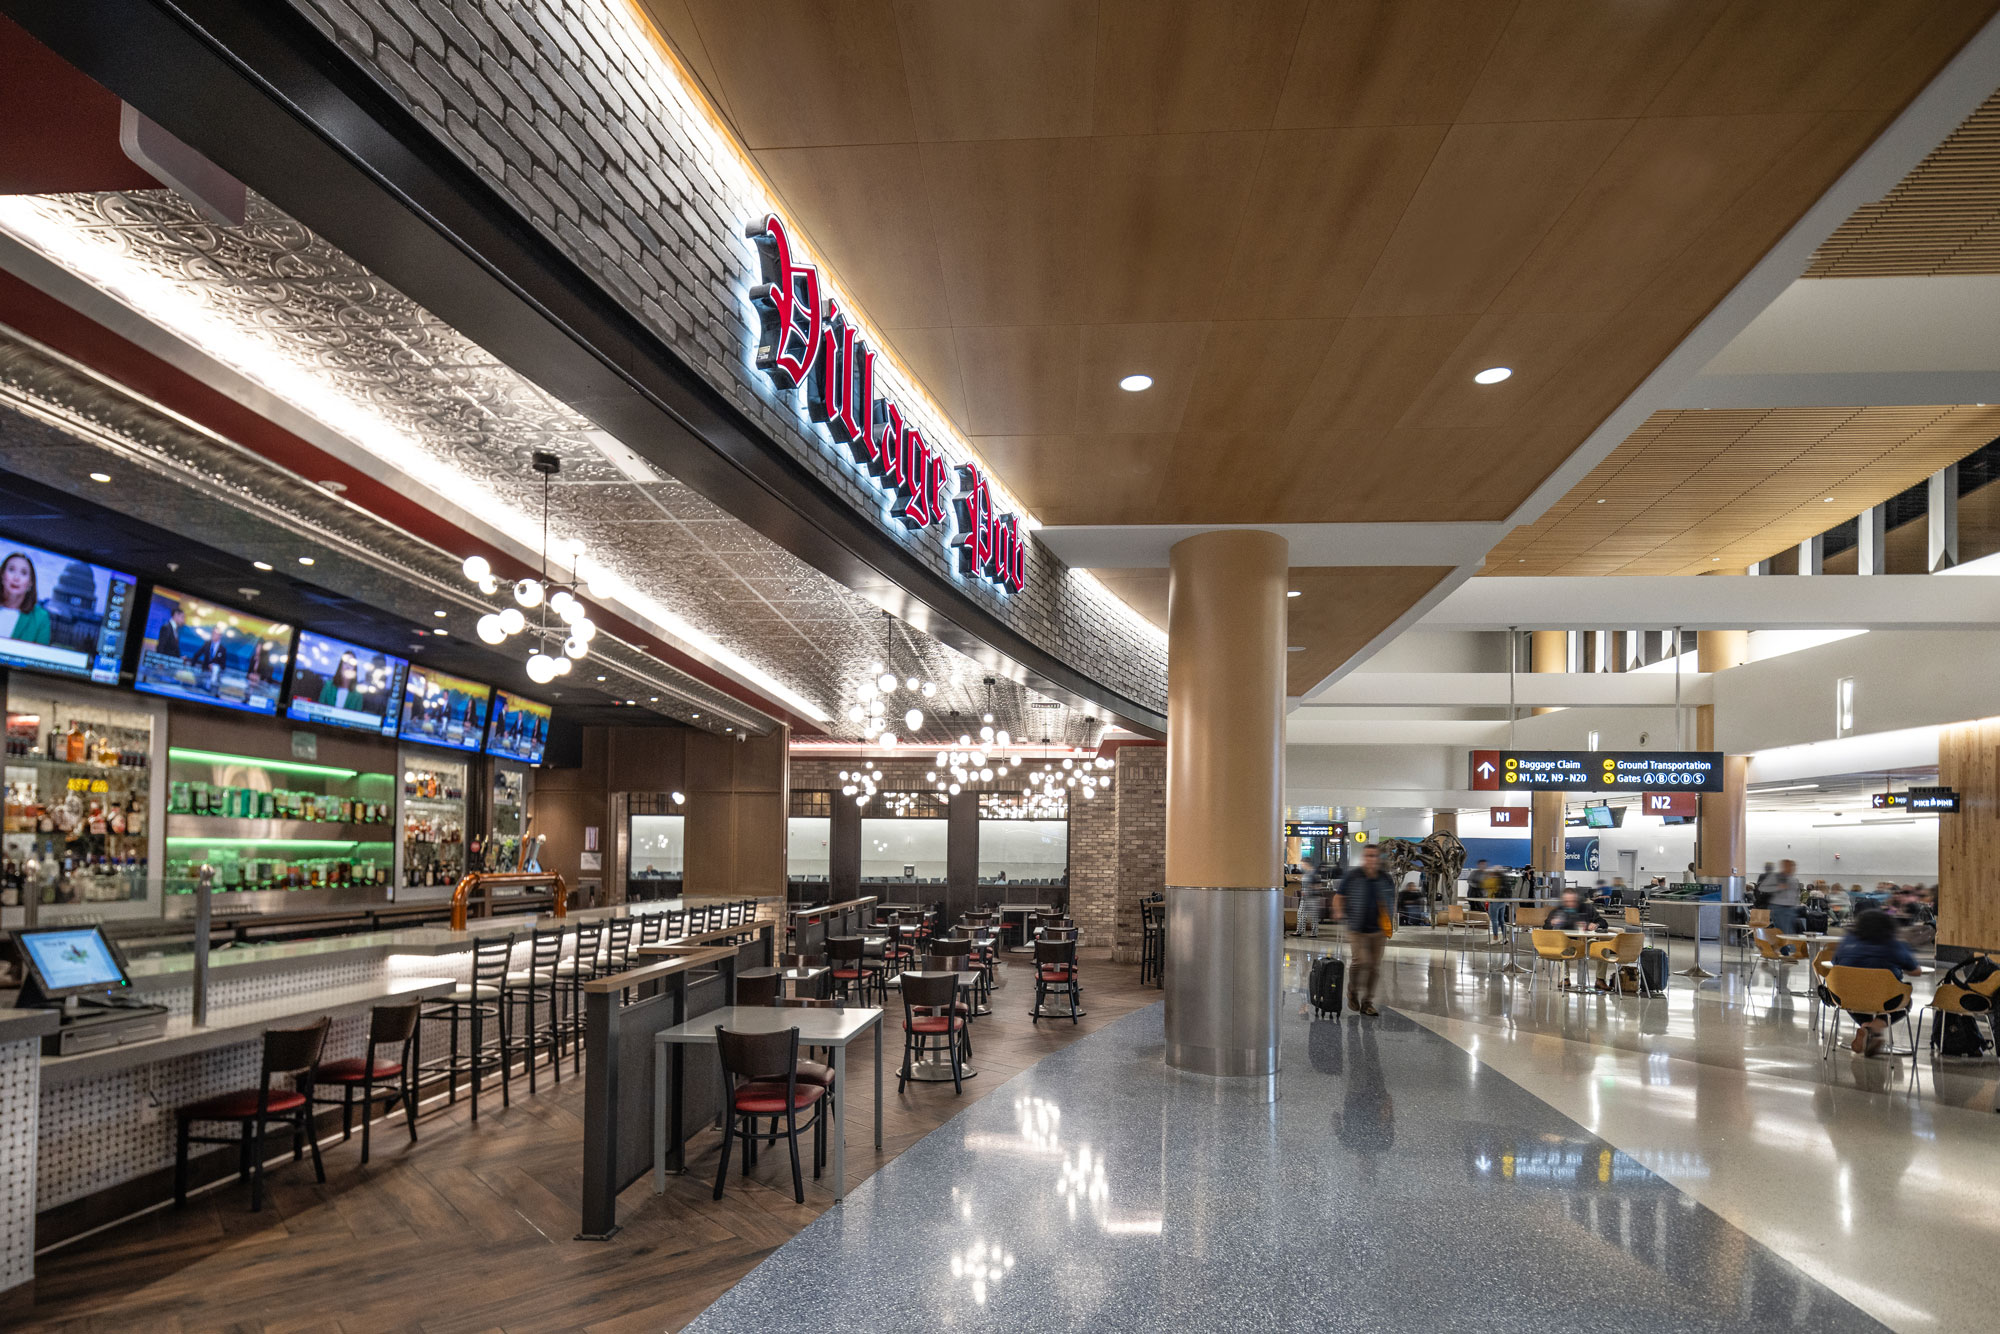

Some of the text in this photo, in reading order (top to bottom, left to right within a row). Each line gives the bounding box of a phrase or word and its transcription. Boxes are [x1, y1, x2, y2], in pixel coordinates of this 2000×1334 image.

[762, 212, 1025, 593] Village Pub
[1519, 760, 1581, 771] Baggage Claim
[1617, 760, 1711, 772] Ground Transportation
[1519, 773, 1533, 783] N1,
[1535, 773, 1549, 783] N2,
[1617, 773, 1642, 783] Gates
[1651, 796, 1671, 809] N2
[1913, 799, 1929, 807] PIKE
[1936, 799, 1953, 807] PINE
[1495, 811, 1510, 822] N1
